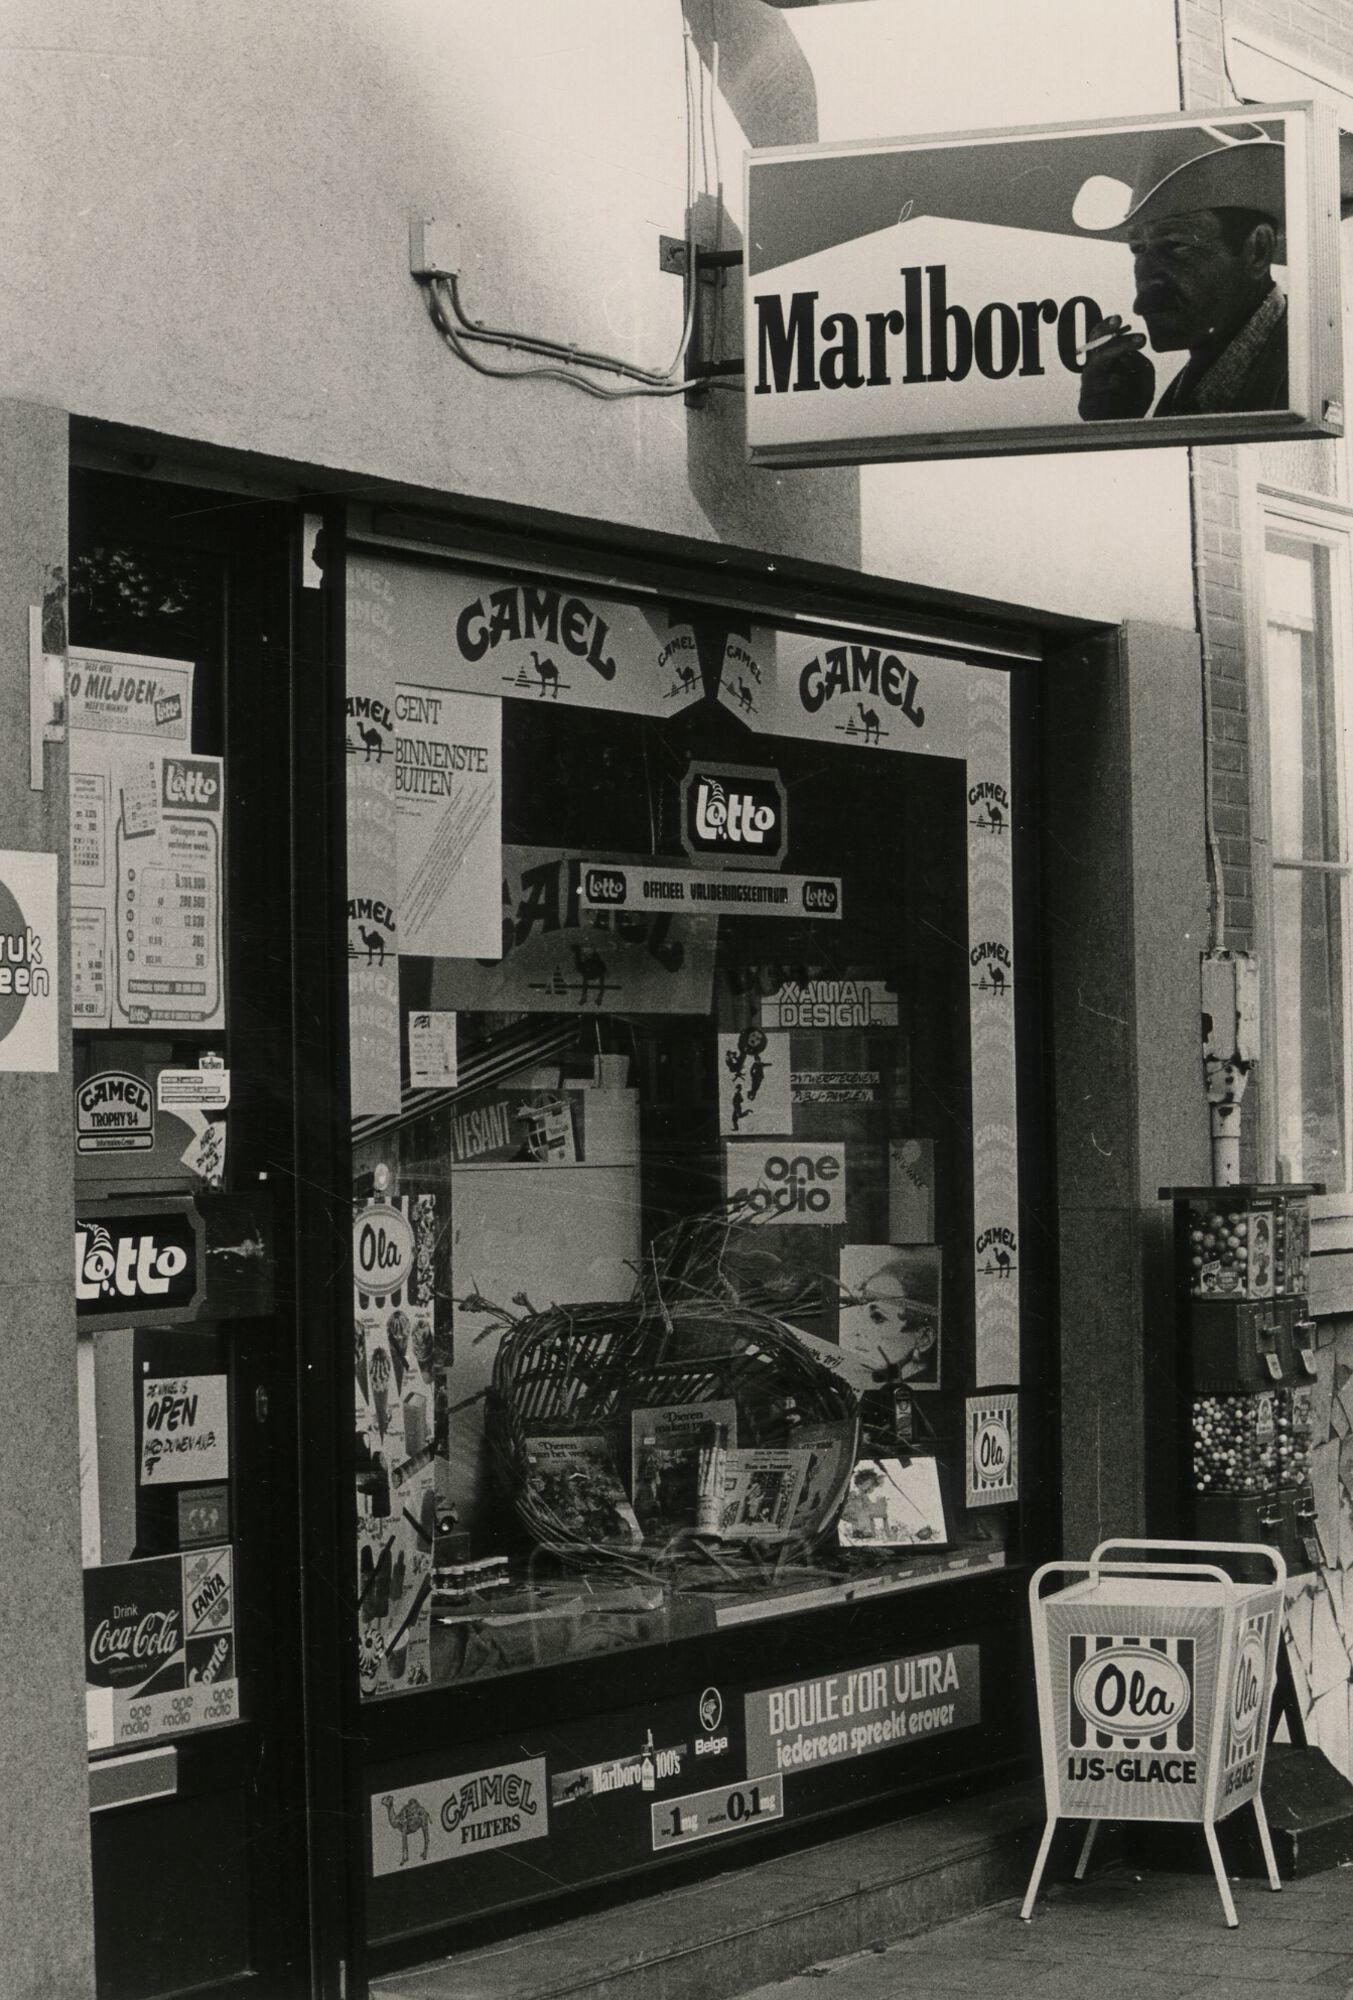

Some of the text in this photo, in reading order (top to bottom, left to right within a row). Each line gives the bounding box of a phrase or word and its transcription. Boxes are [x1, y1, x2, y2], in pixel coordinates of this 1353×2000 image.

[754, 265, 1102, 394] Marlboro
[456, 586, 616, 681] CAMEL
[658, 636, 695, 667] CAMEL
[727, 645, 761, 684] CAMEL
[66, 671, 81, 697] 0
[85, 674, 157, 704] MILJOEN
[800, 646, 924, 728] CAMEL
[395, 694, 442, 725] GENT
[395, 738, 488, 773] BINNENSTE
[165, 764, 217, 803] Lotto
[395, 766, 453, 797] BUITEN
[969, 782, 1008, 809] CAMEL
[695, 784, 775, 843] Lotto
[588, 871, 835, 907] Lotto OFFICIEEL VALIDERINGSCENTRUM Lotto
[970, 942, 1011, 969] CAMEL
[80, 1080, 148, 1112] CAMEL
[91, 1112, 126, 1127] TROPHY
[451, 1101, 510, 1161] VESANT
[765, 1155, 840, 1181] one
[360, 1223, 401, 1271] Ola
[976, 1227, 1016, 1254] CAMEL
[75, 1231, 187, 1299] Lotto
[147, 1394, 198, 1431] OPEN
[981, 1432, 1004, 1467] Ola
[113, 1603, 138, 1620] Drink
[192, 1573, 225, 1619] FANTA
[90, 1609, 179, 1664] Coca-Cola
[172, 1695, 193, 1712] one
[212, 1687, 234, 1704] one
[769, 1652, 959, 1735] BOULE d'OR ULTRA
[1094, 1663, 1174, 1717] Ola
[1235, 1653, 1258, 1720] Ola
[121, 1719, 149, 1736] radio
[130, 1705, 151, 1719] one
[163, 1711, 191, 1726] radio
[204, 1702, 231, 1719] radio
[695, 1737, 727, 1755] Belga
[776, 1703, 955, 1768] iedereen spreekt erover
[593, 1750, 681, 1794] Marlboro 100's
[1068, 1757, 1197, 1784] IJS-GLACE
[441, 1773, 537, 1832] CAMEL
[461, 1814, 521, 1844] FILTERS
